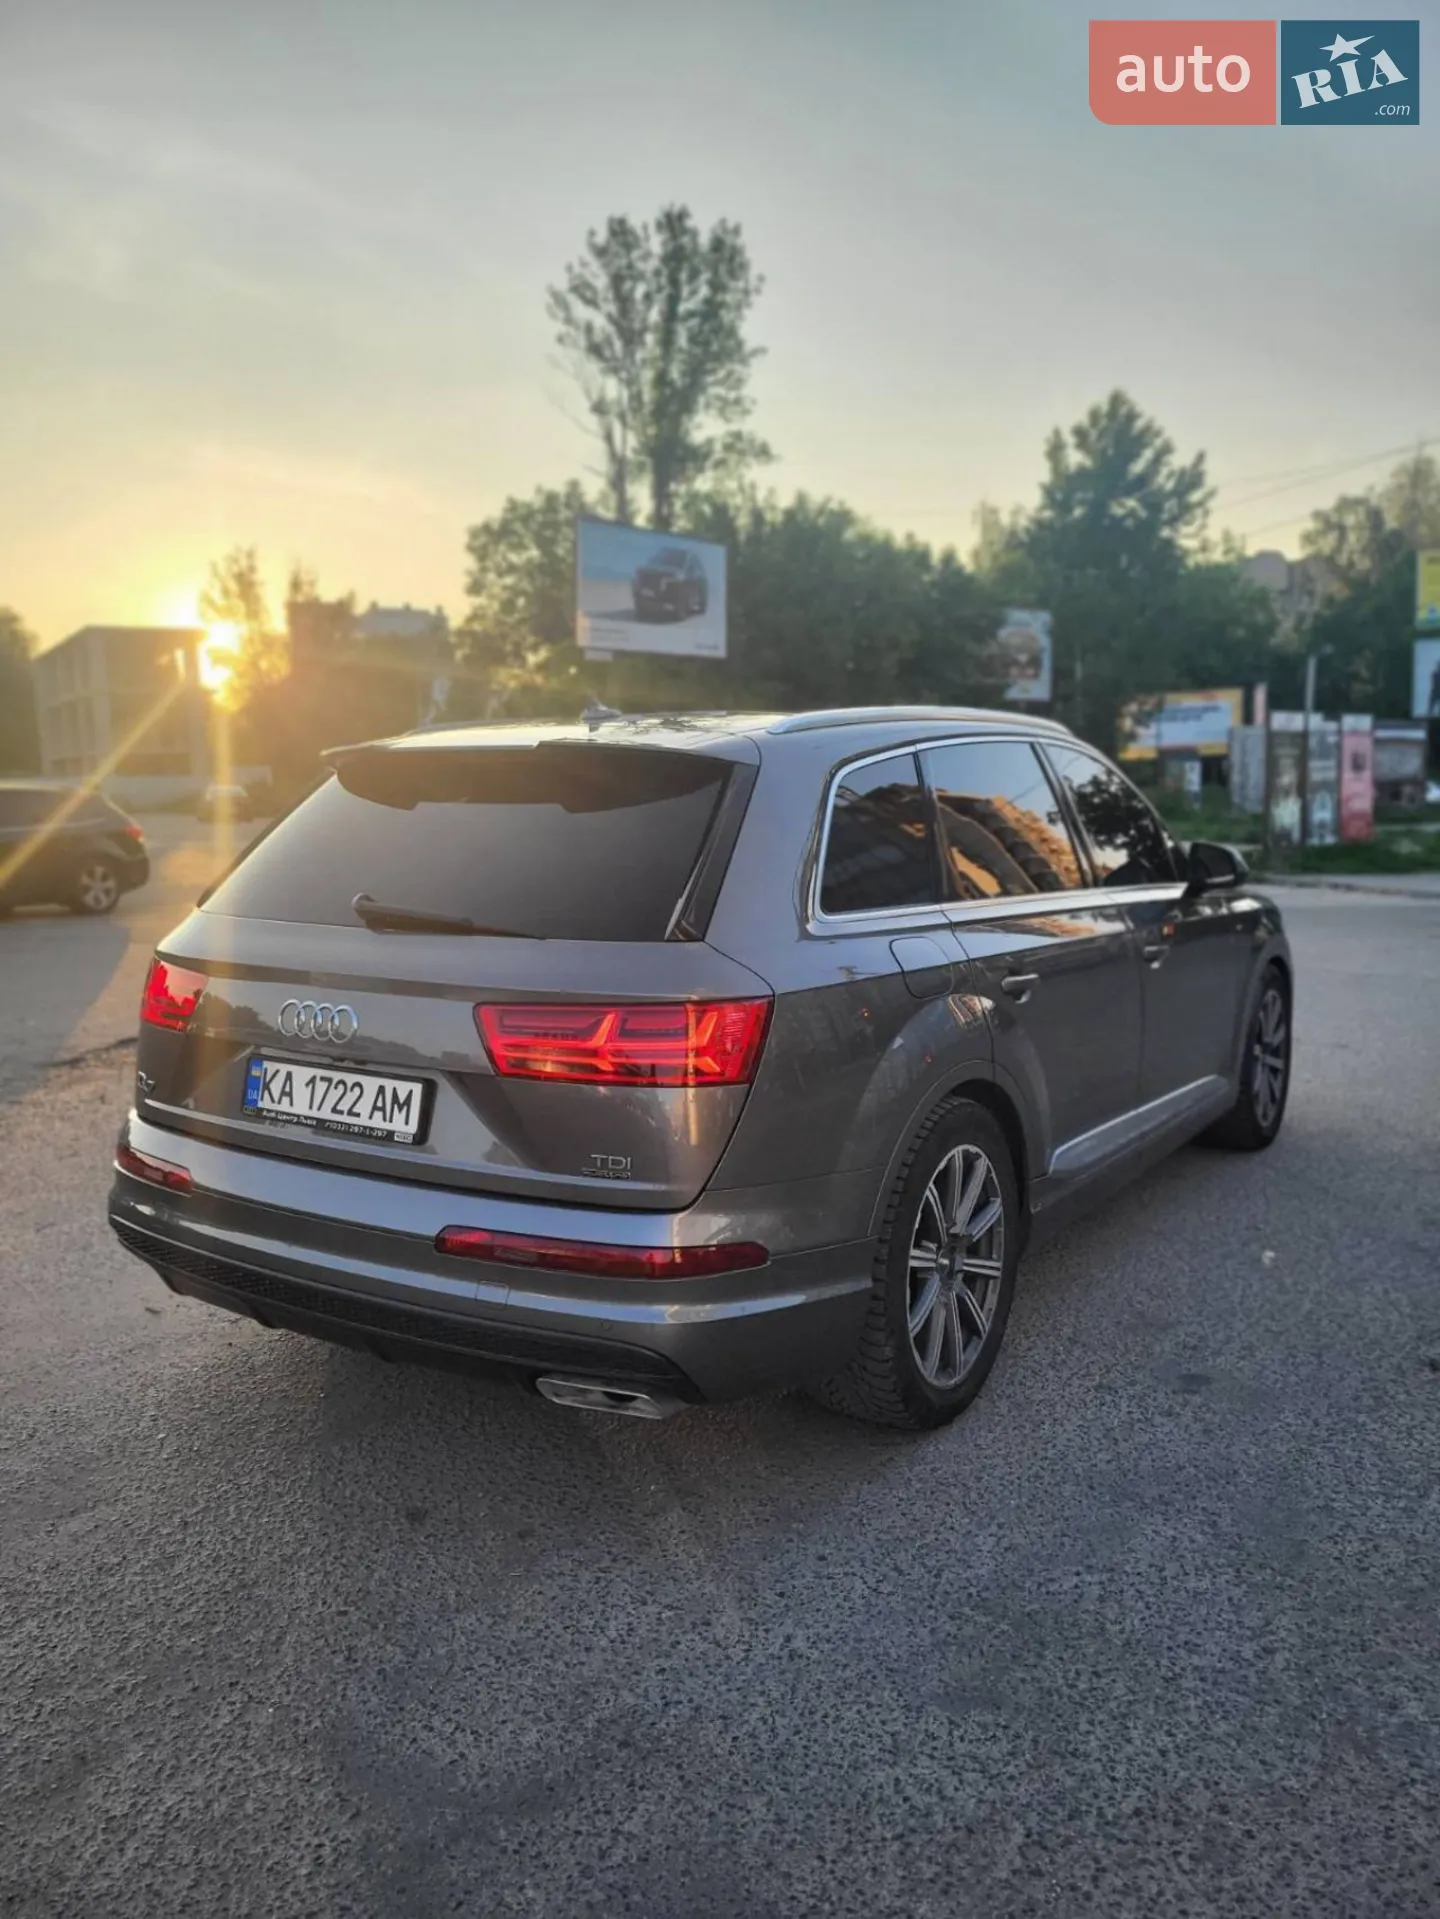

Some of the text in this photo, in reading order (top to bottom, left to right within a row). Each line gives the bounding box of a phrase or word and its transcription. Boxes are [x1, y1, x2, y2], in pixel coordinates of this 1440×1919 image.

[261, 1067, 413, 1126] KA 1722 AM
[589, 1154, 631, 1170] TDI
